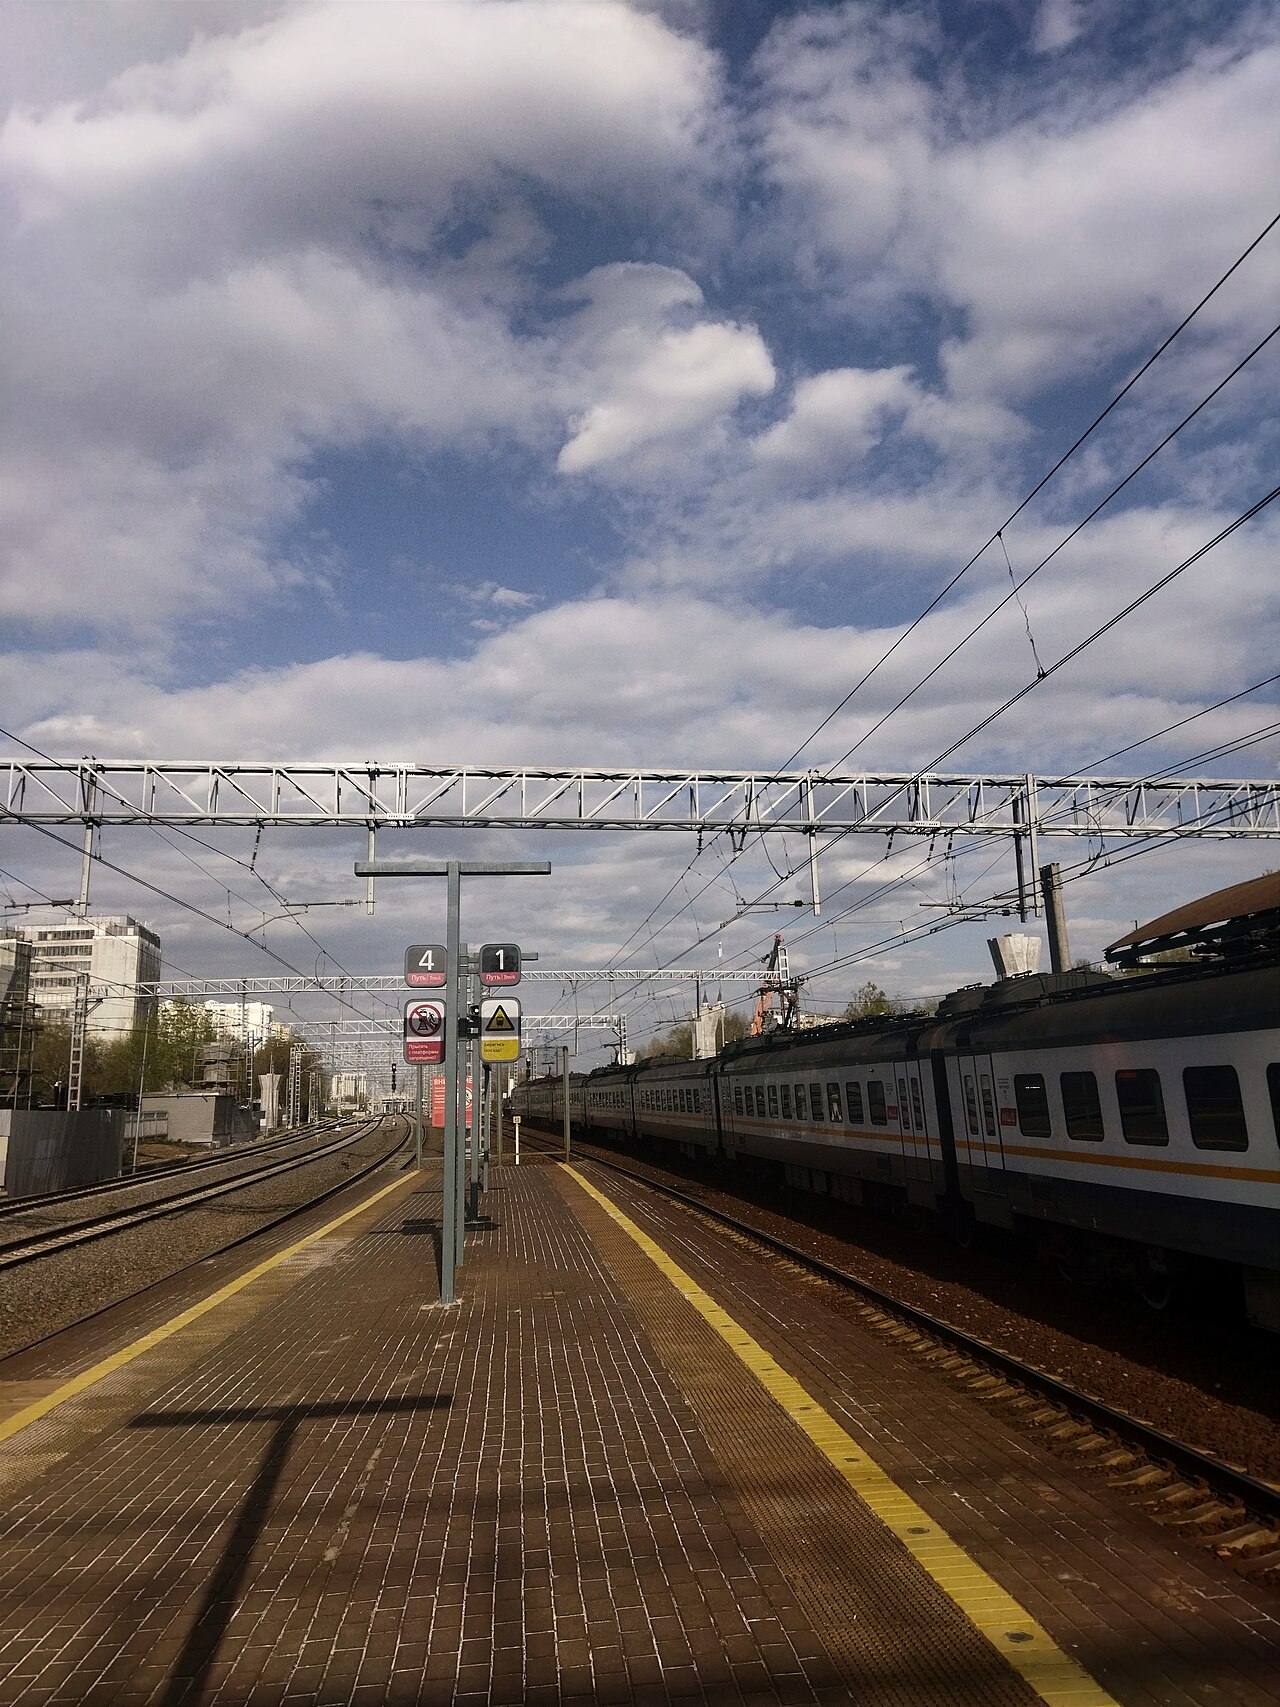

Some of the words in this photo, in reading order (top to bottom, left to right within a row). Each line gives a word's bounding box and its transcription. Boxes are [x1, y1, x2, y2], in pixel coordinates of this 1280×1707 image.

[418, 949, 435, 971] 4
[495, 949, 504, 970] 1
[411, 974, 427, 982] Путь
[486, 974, 501, 982] Путь
